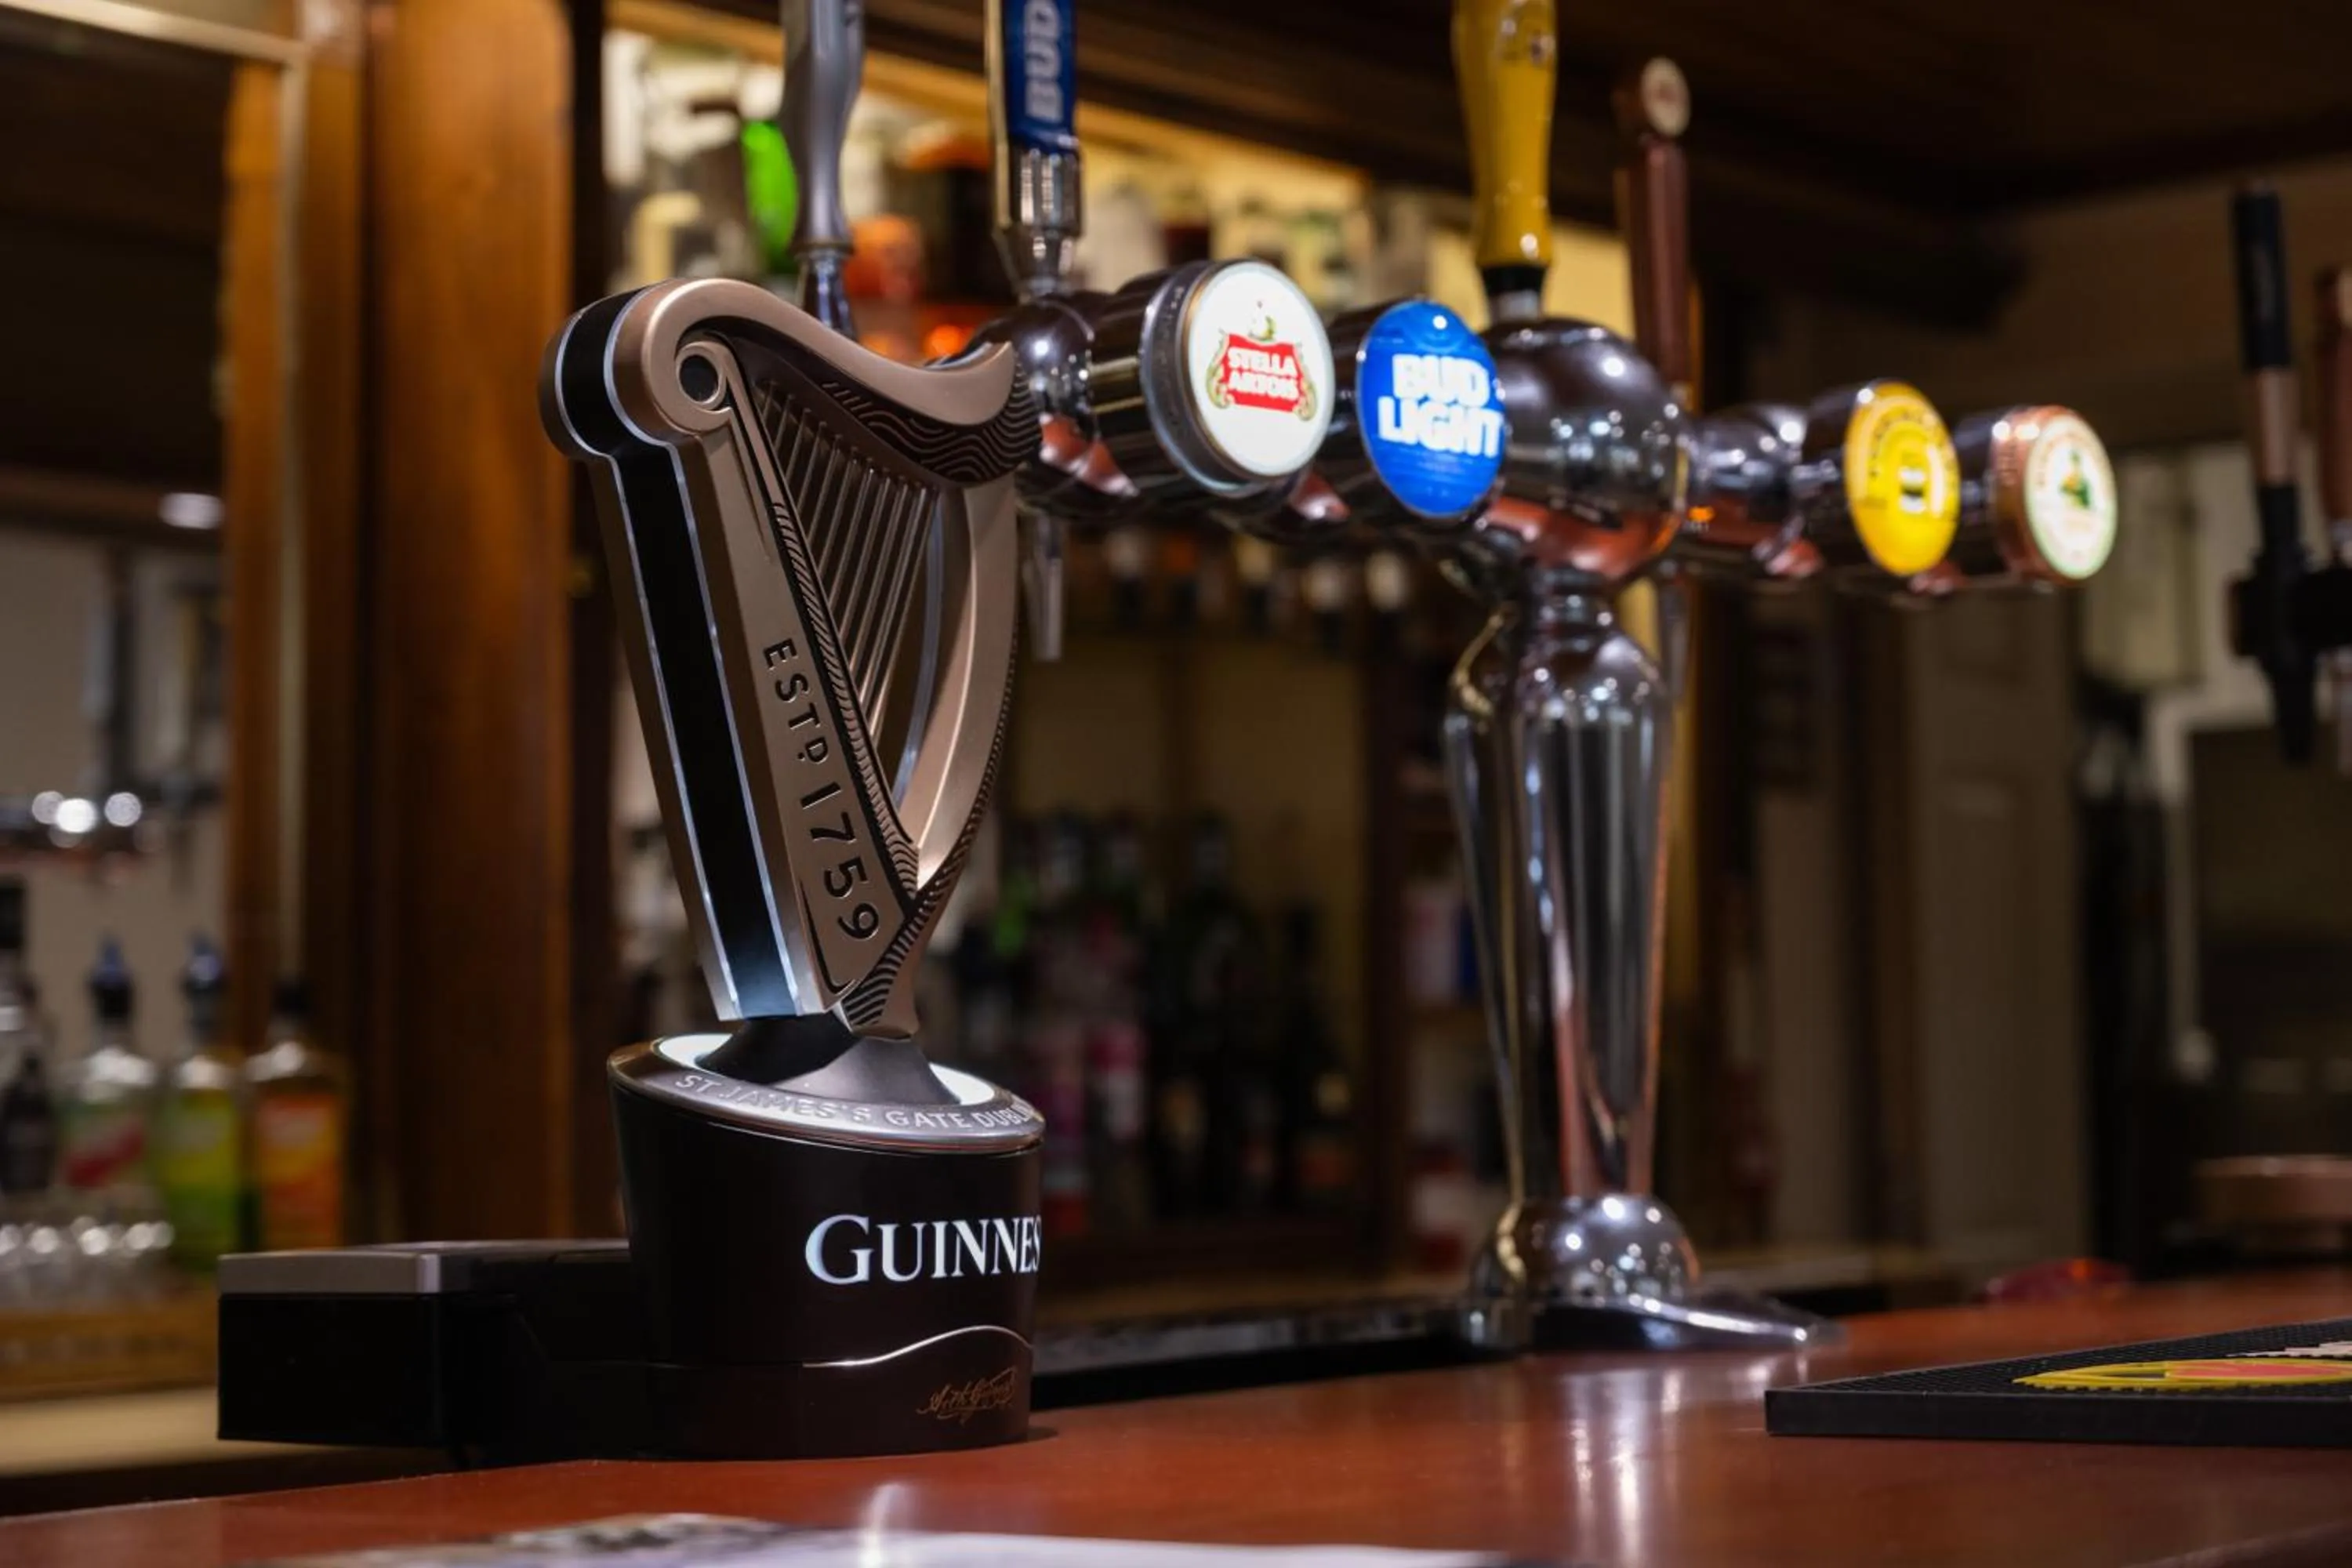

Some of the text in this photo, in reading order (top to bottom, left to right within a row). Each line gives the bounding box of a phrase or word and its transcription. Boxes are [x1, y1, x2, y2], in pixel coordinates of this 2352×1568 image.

[1228, 347, 1298, 378] STELLA
[1392, 354, 1490, 408] BUD
[1377, 395, 1504, 459] LIGHT
[800, 782, 880, 940] 1759
[885, 1110, 973, 1128] GATE
